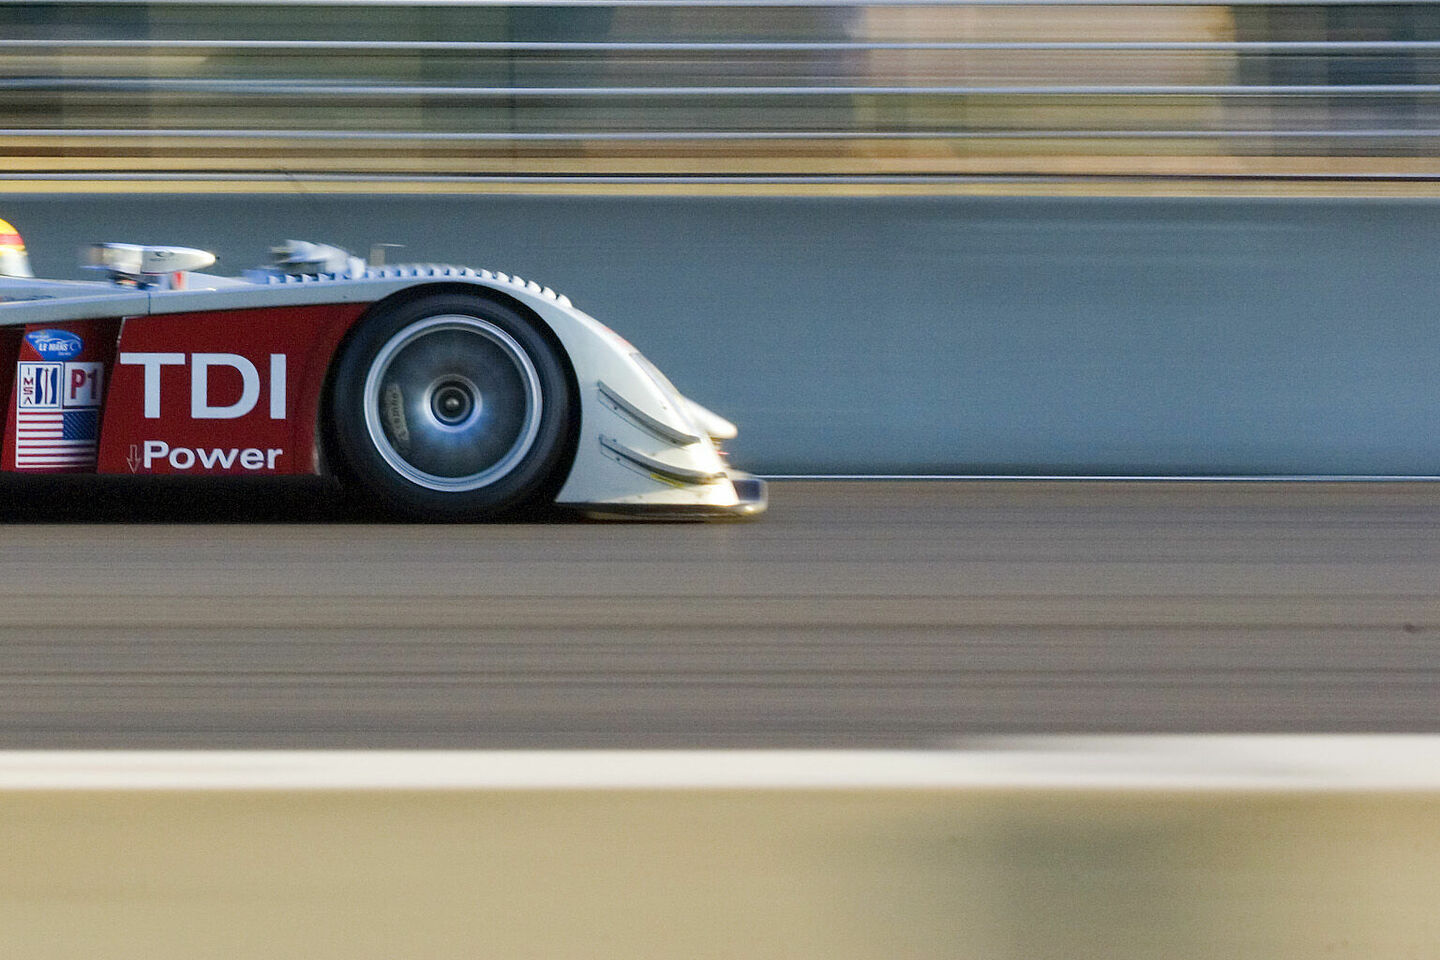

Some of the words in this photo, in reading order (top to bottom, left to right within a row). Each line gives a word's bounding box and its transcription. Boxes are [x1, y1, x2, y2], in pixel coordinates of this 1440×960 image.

[23, 367, 34, 405] IMSA
[70, 368, 98, 400] P1
[120, 352, 287, 420] TDI
[143, 440, 284, 470] Power
